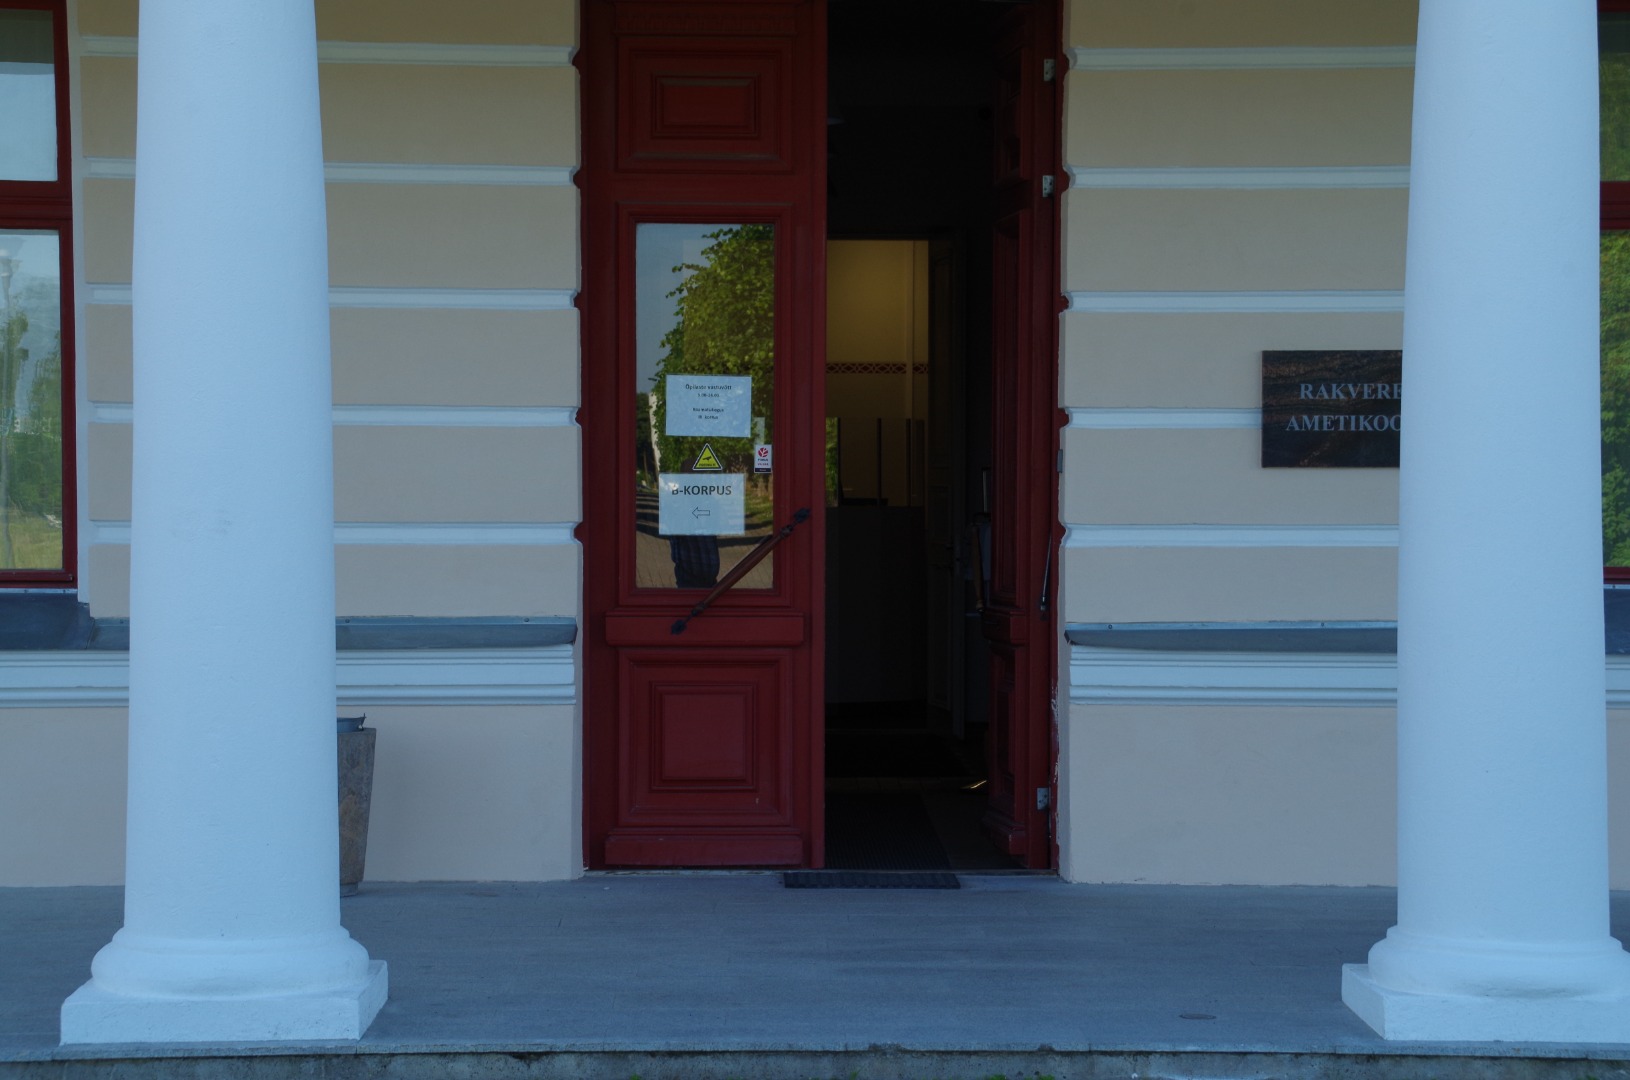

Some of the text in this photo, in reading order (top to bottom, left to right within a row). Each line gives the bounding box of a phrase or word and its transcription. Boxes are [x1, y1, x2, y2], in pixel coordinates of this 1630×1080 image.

[1299, 383, 1402, 400] RAKVERE
[1286, 415, 1401, 431] AMETIKOO
[672, 485, 732, 496] B-KORPUS
